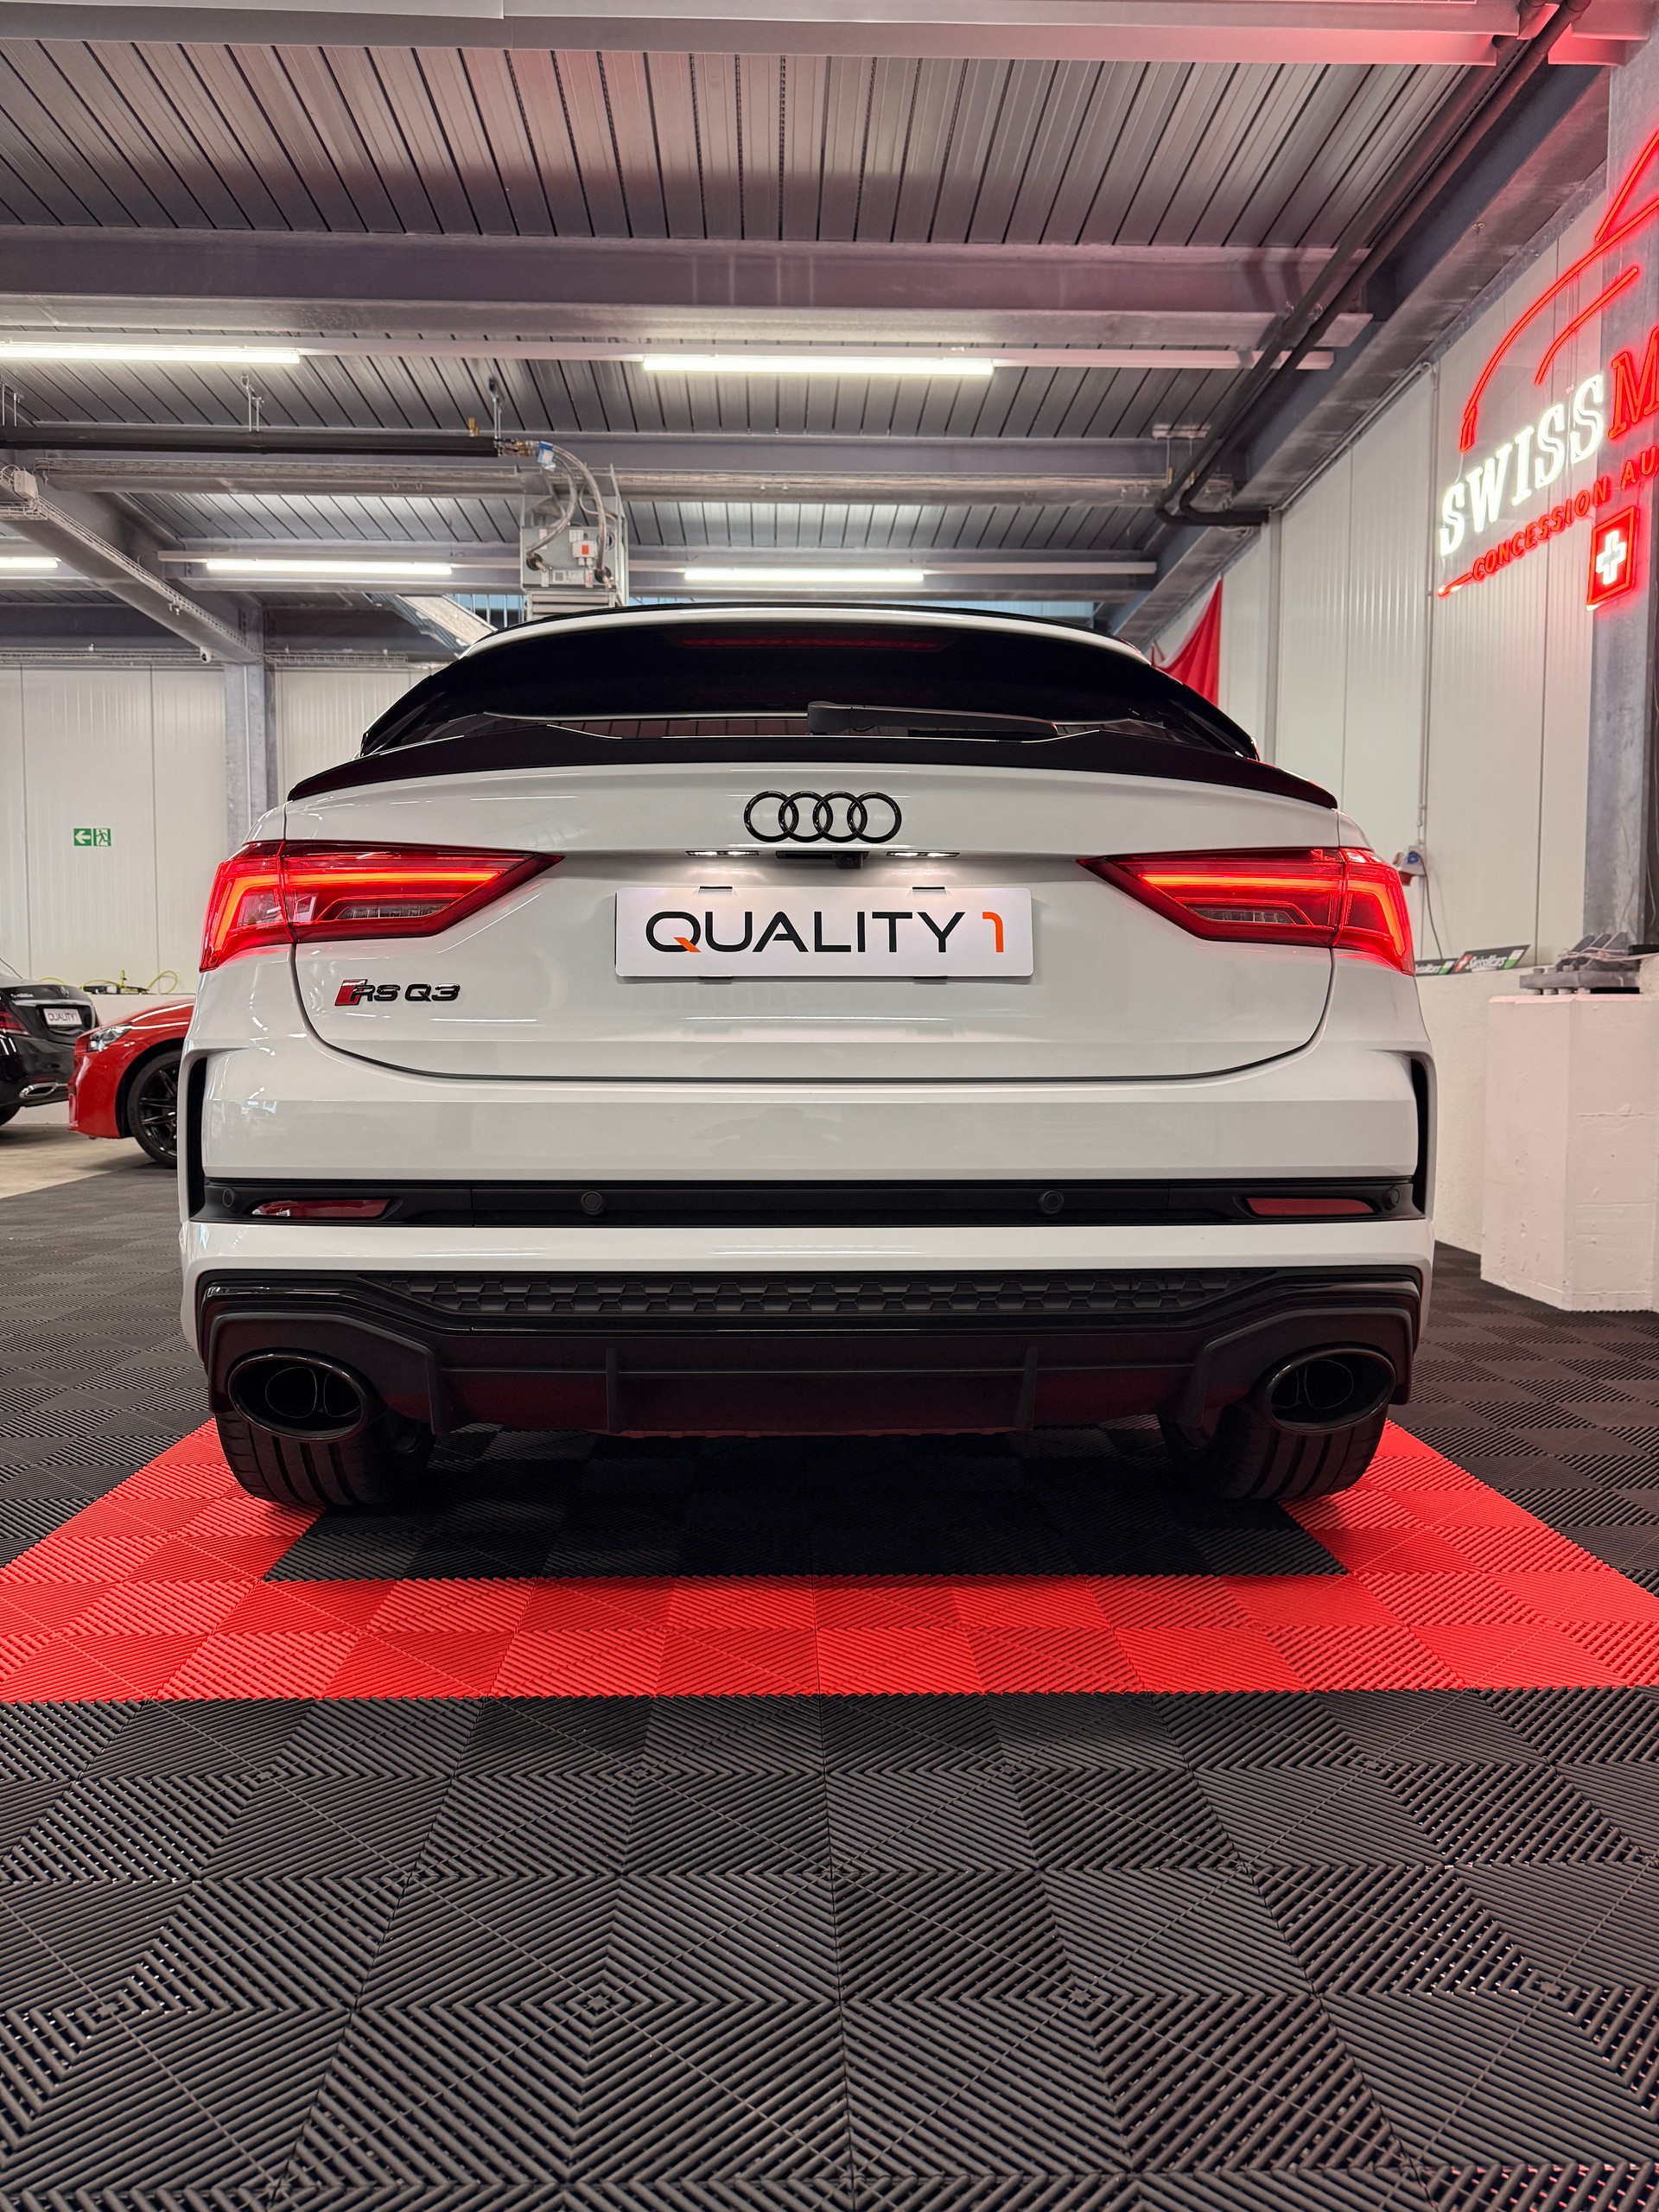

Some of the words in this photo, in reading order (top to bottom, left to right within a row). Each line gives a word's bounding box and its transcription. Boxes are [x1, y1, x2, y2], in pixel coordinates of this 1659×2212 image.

[1471, 476, 1611, 582] CONCESSION
[645, 910, 966, 953] QUALITY
[982, 911, 1004, 953] 1
[342, 982, 401, 1003] RS
[404, 983, 461, 1002] Q3
[48, 1012, 74, 1021] QUALITY
